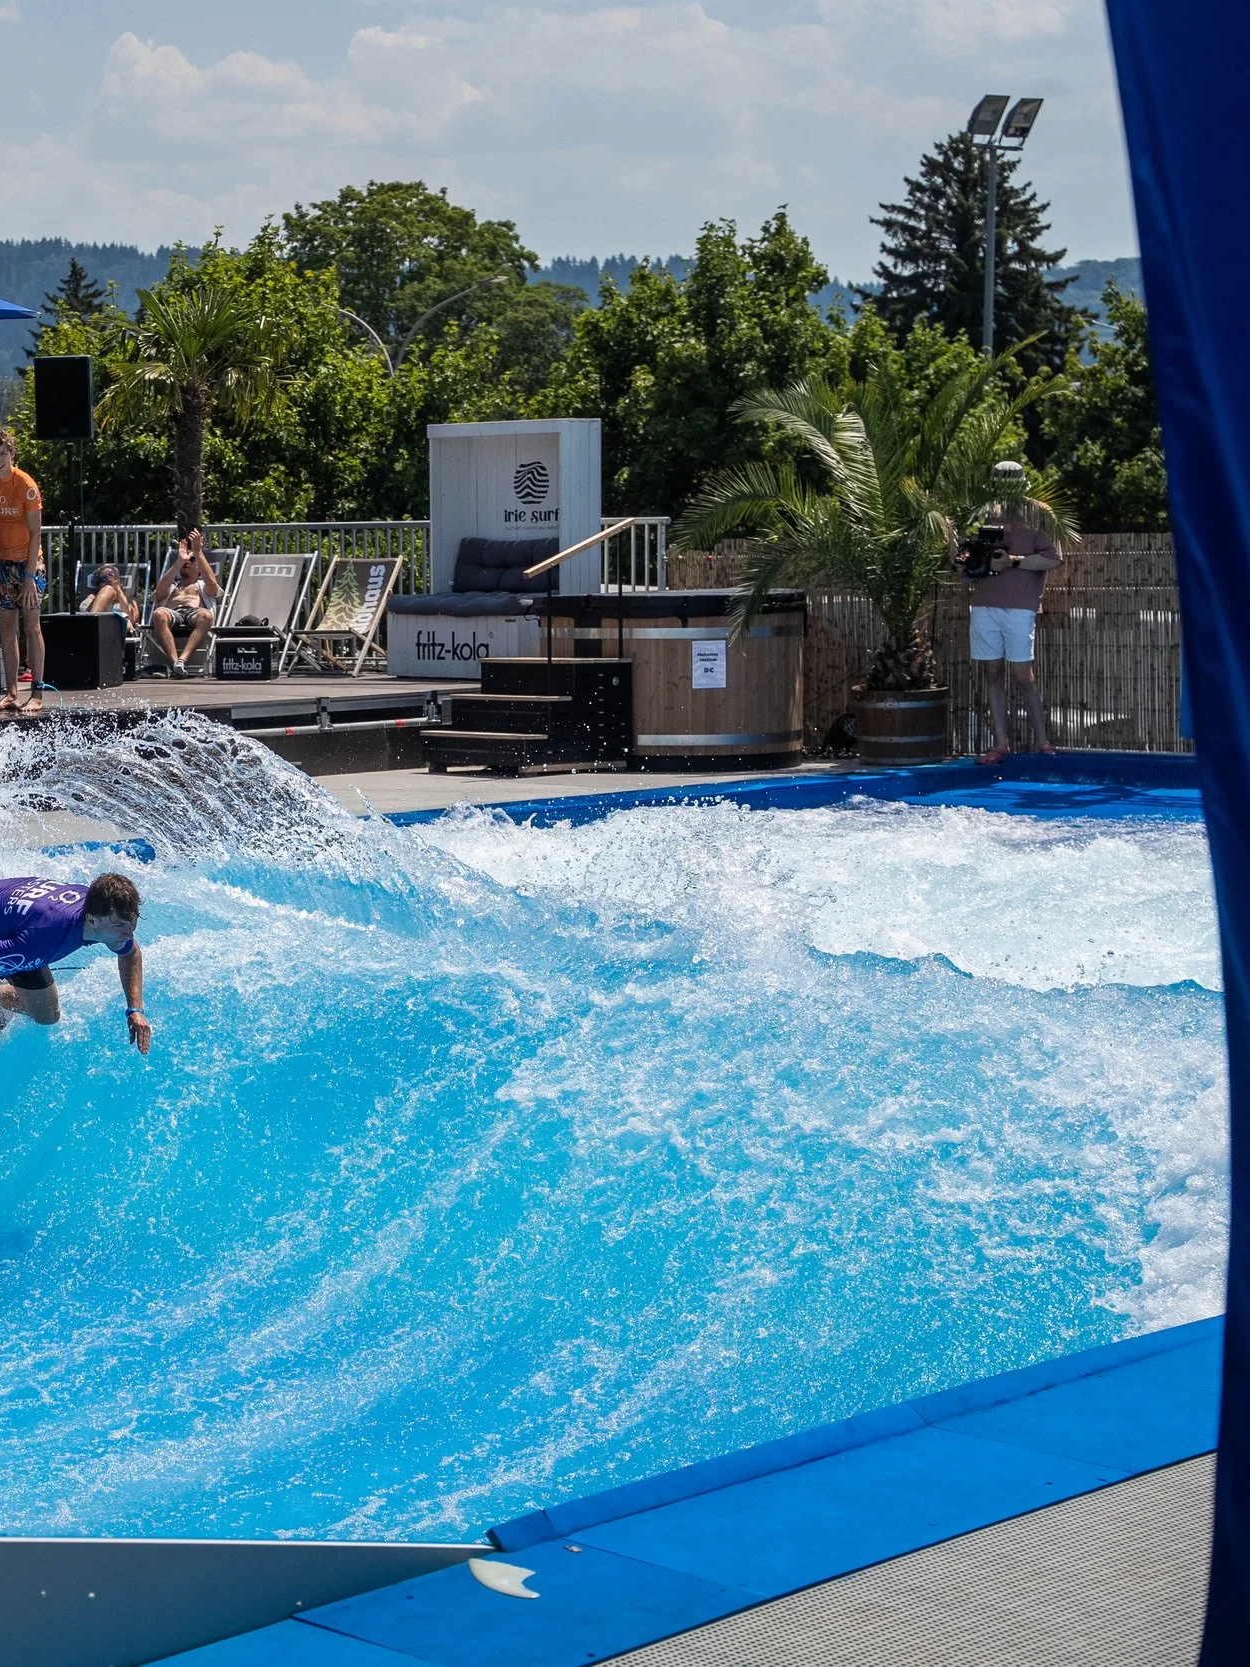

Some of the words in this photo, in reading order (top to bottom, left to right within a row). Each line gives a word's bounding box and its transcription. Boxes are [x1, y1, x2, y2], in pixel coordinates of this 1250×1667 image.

[504, 509, 526, 522] irie
[530, 507, 560, 524] surf
[415, 630, 490, 661] fritz-kola
[222, 657, 262, 671] fritz-kola
